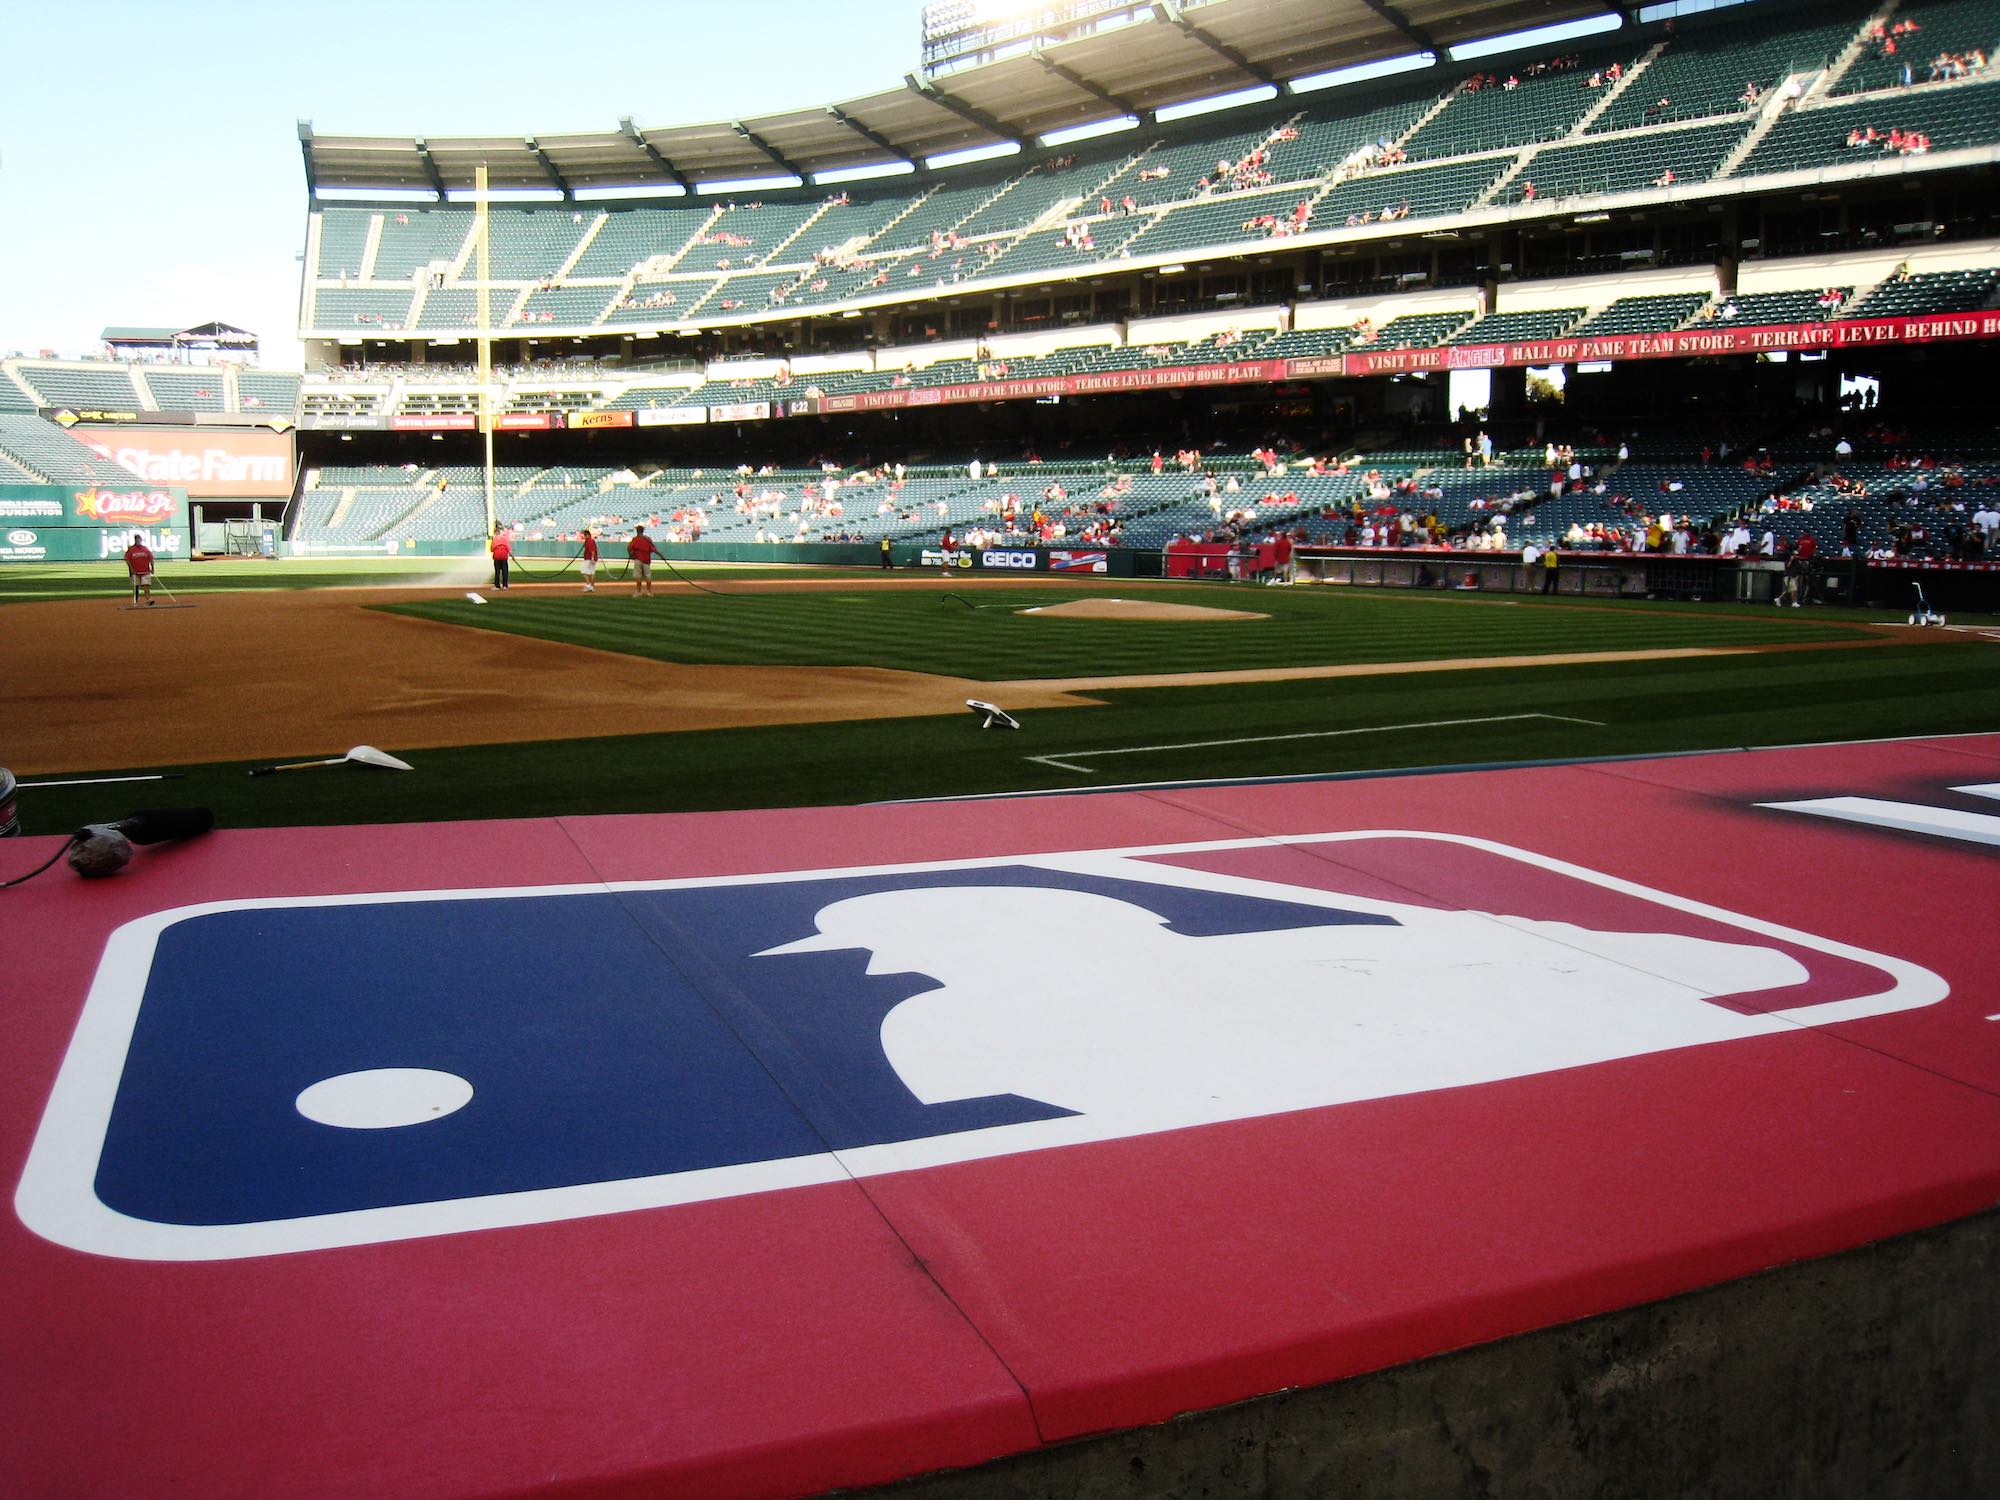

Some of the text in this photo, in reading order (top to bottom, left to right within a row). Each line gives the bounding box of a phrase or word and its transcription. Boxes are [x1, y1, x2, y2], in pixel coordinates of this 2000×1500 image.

[1368, 354, 1406, 369] VISIT
[1411, 352, 1440, 366] THE
[1448, 347, 1505, 368] ANGELS
[1513, 346, 1552, 361] HALL
[1559, 343, 1578, 357] OF
[1583, 340, 1624, 356] FAME
[1629, 337, 1673, 354] TEAM
[1679, 334, 1734, 351] STORE
[1752, 328, 1833, 347] TERRACE
[1839, 325, 1899, 342] LEVEL
[1905, 319, 1977, 338] BEHIND
[864, 393, 887, 406] VISIT
[888, 391, 904, 404] THE
[945, 388, 967, 400] HALL
[969, 386, 980, 398] OF
[983, 385, 1006, 396] FAME
[1009, 383, 1034, 394] TEAM
[1036, 380, 1066, 392] STORE
[1076, 376, 1119, 390] TERRACE
[1122, 374, 1153, 387] LEVEL
[1157, 371, 1194, 385] BEHIND
[1197, 369, 1225, 381] HOME
[1228, 366, 1261, 379] PLATE
[791, 401, 808, 413] 6:22
[116, 447, 285, 481] State Farm
[97, 492, 177, 514] Carl's Jr.
[983, 551, 1036, 568] GEICO
